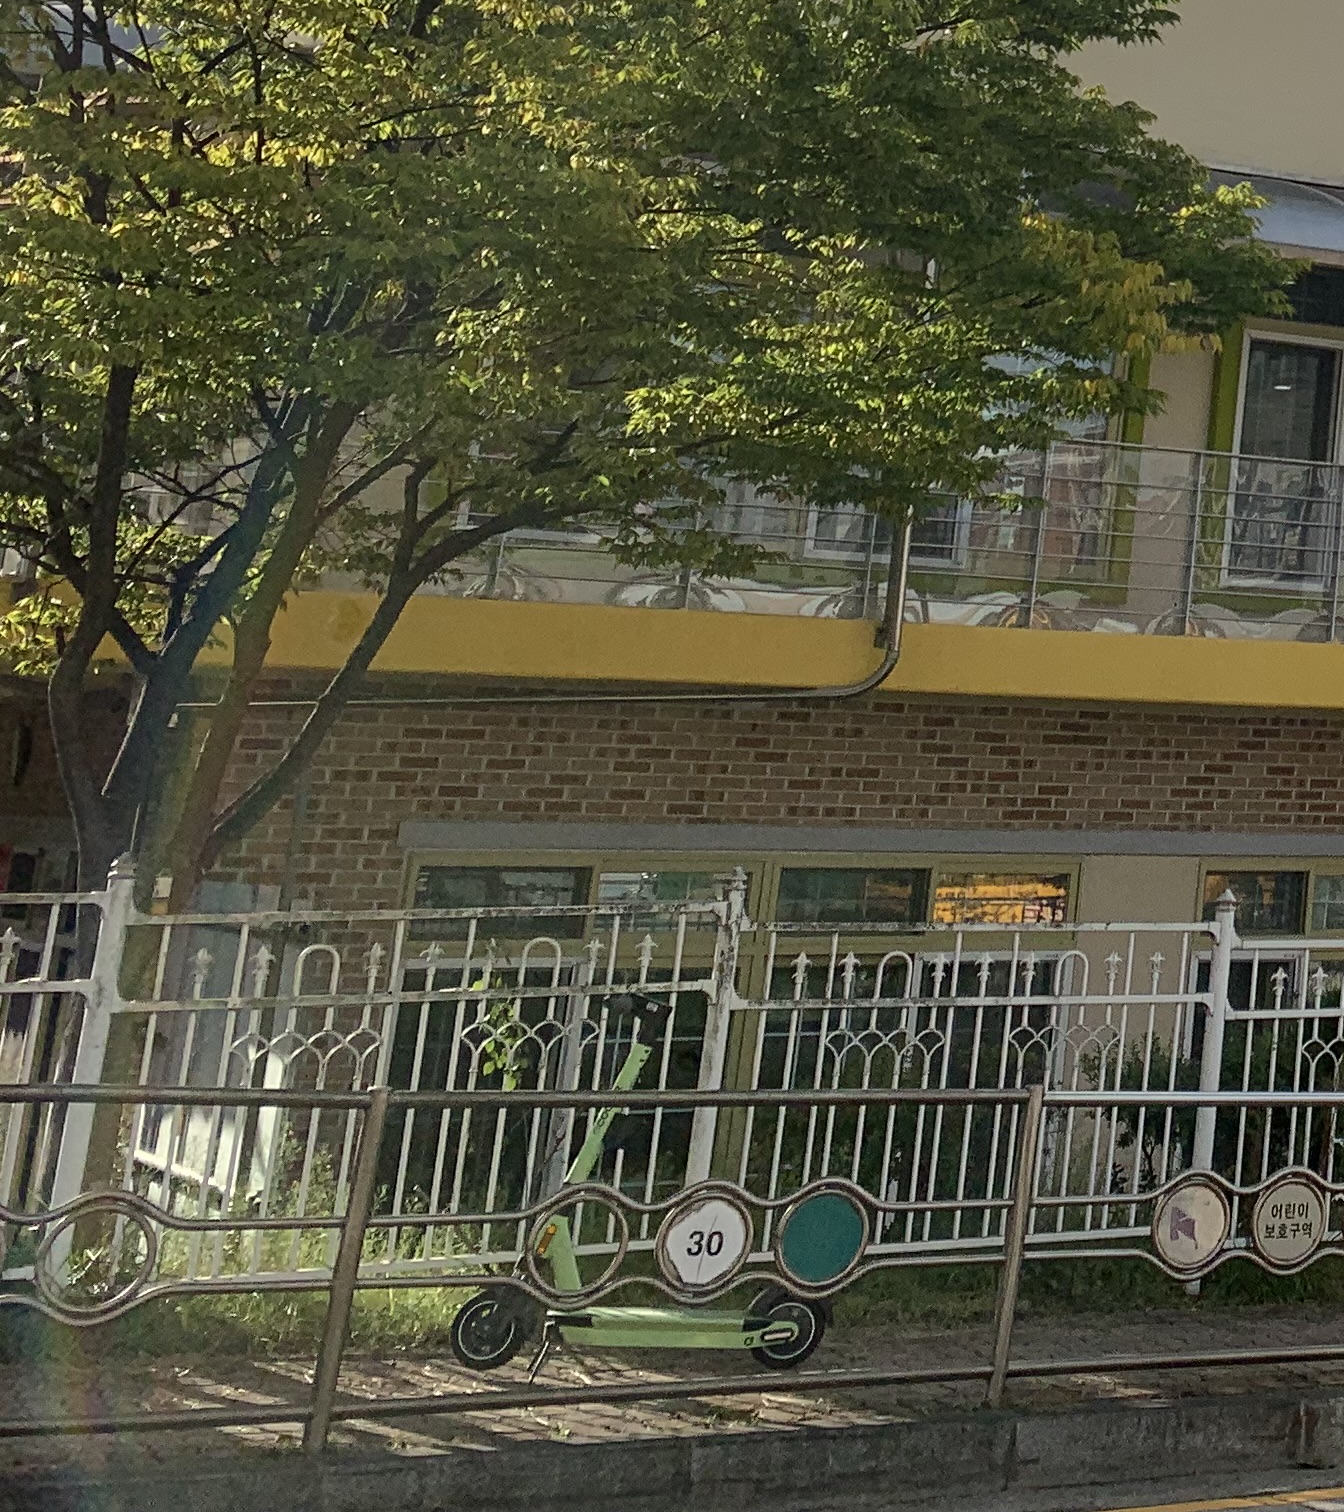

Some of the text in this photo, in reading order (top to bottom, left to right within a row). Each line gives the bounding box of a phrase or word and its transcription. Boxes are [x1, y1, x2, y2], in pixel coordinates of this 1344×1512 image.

[1271, 1202, 1309, 1219] 어린이
[1264, 1220, 1313, 1239] 보호구역
[686, 1230, 724, 1256] 30
